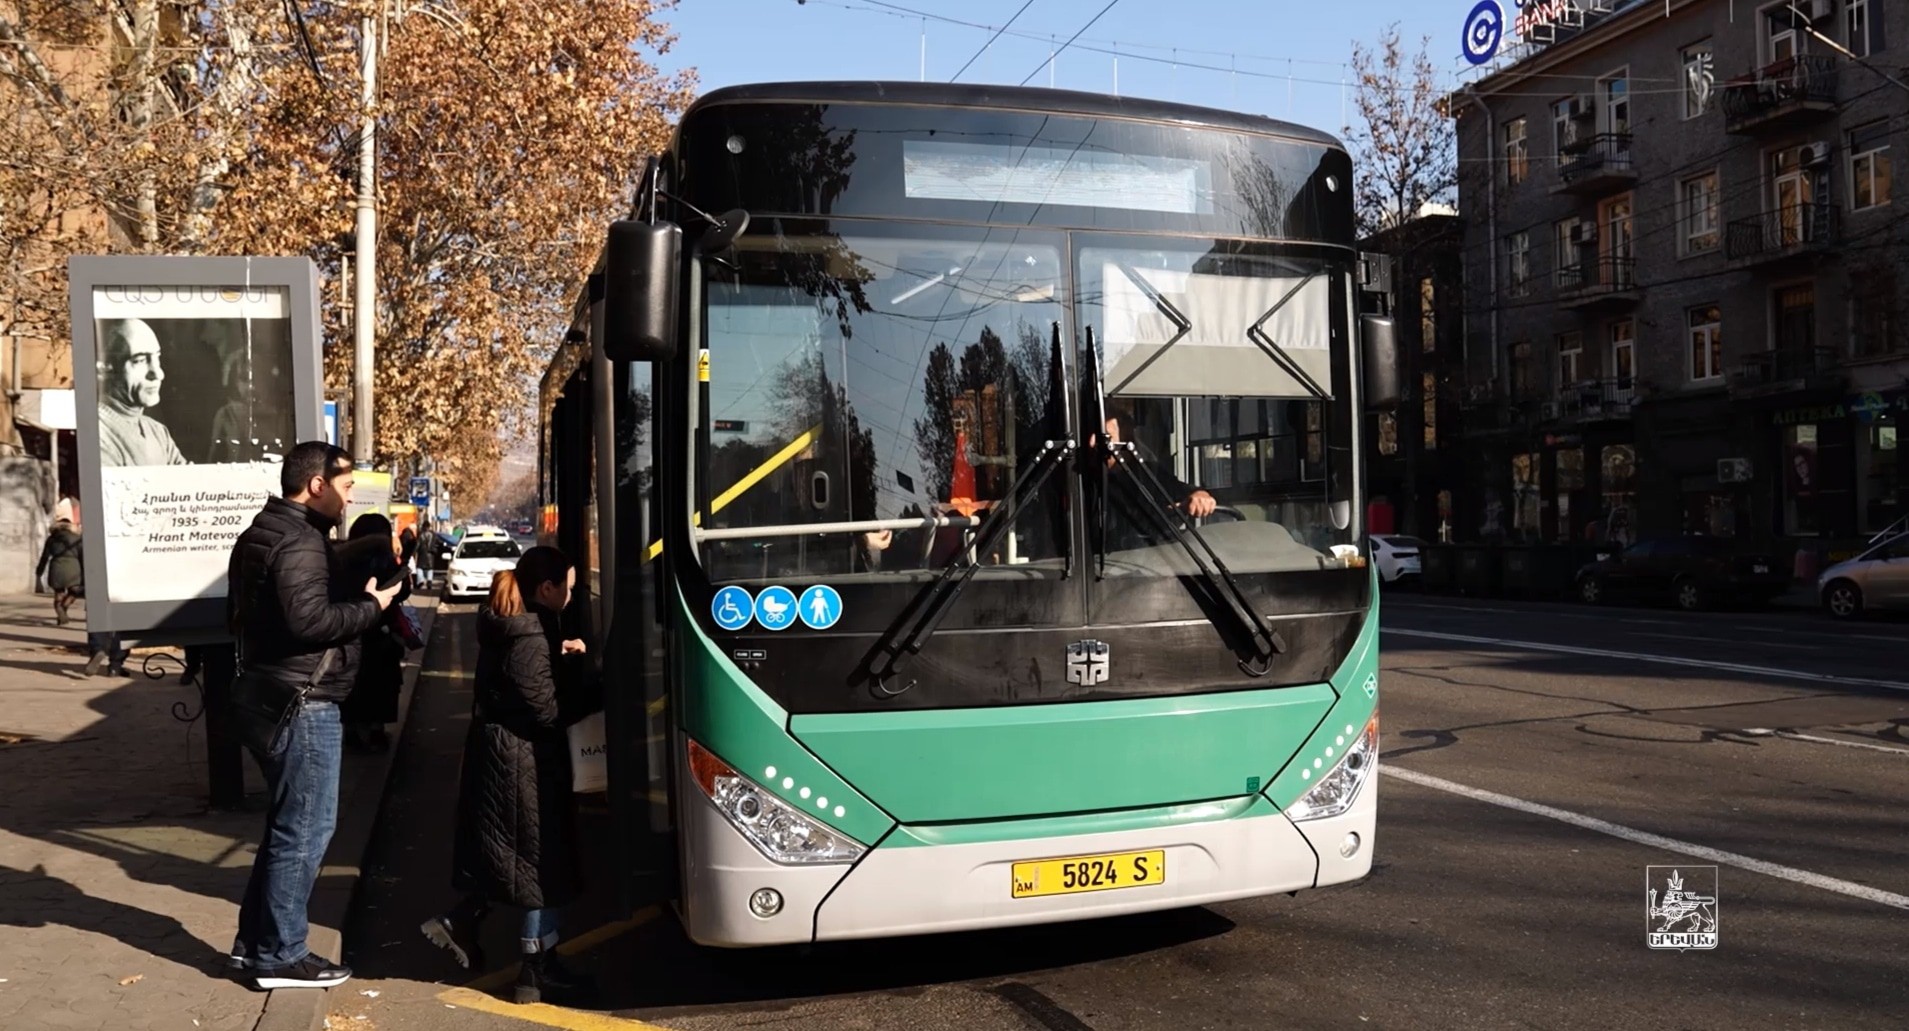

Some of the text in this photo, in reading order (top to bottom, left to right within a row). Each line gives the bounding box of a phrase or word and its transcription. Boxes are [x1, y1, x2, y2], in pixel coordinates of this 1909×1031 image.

[142, 492, 191, 505] Հրանտ
[172, 517, 199, 528] 1935
[211, 515, 242, 526] 2002
[148, 532, 185, 543] Hrant
[142, 545, 188, 553] Armenian
[190, 543, 219, 552] writer,
[1063, 856, 1148, 888] 5824 S
[1016, 882, 1033, 893] AM
